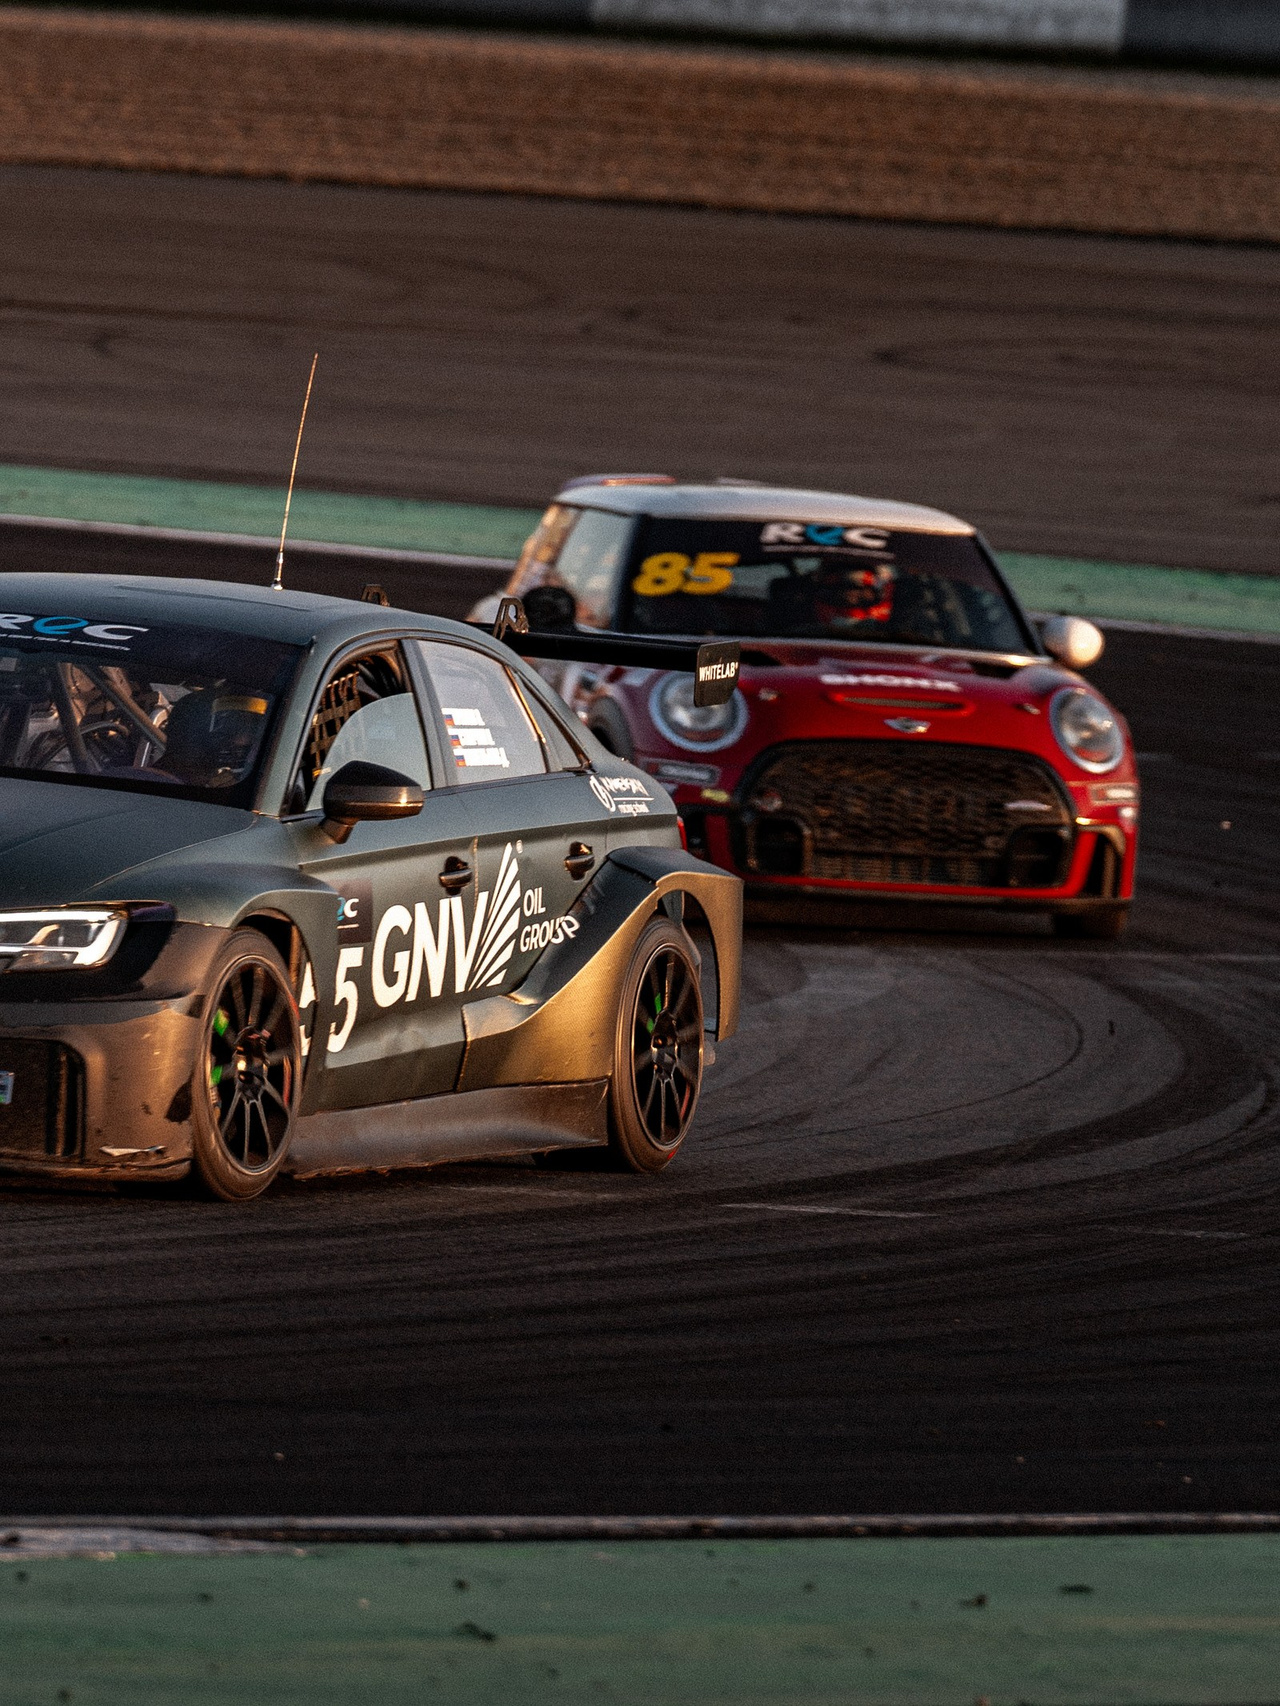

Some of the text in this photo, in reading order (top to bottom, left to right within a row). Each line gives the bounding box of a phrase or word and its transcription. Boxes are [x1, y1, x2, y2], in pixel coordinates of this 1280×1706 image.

[632, 552, 741, 595] 85
[523, 886, 546, 917] OIL
[372, 891, 489, 1008] GNV
[520, 914, 580, 953] GROUP
